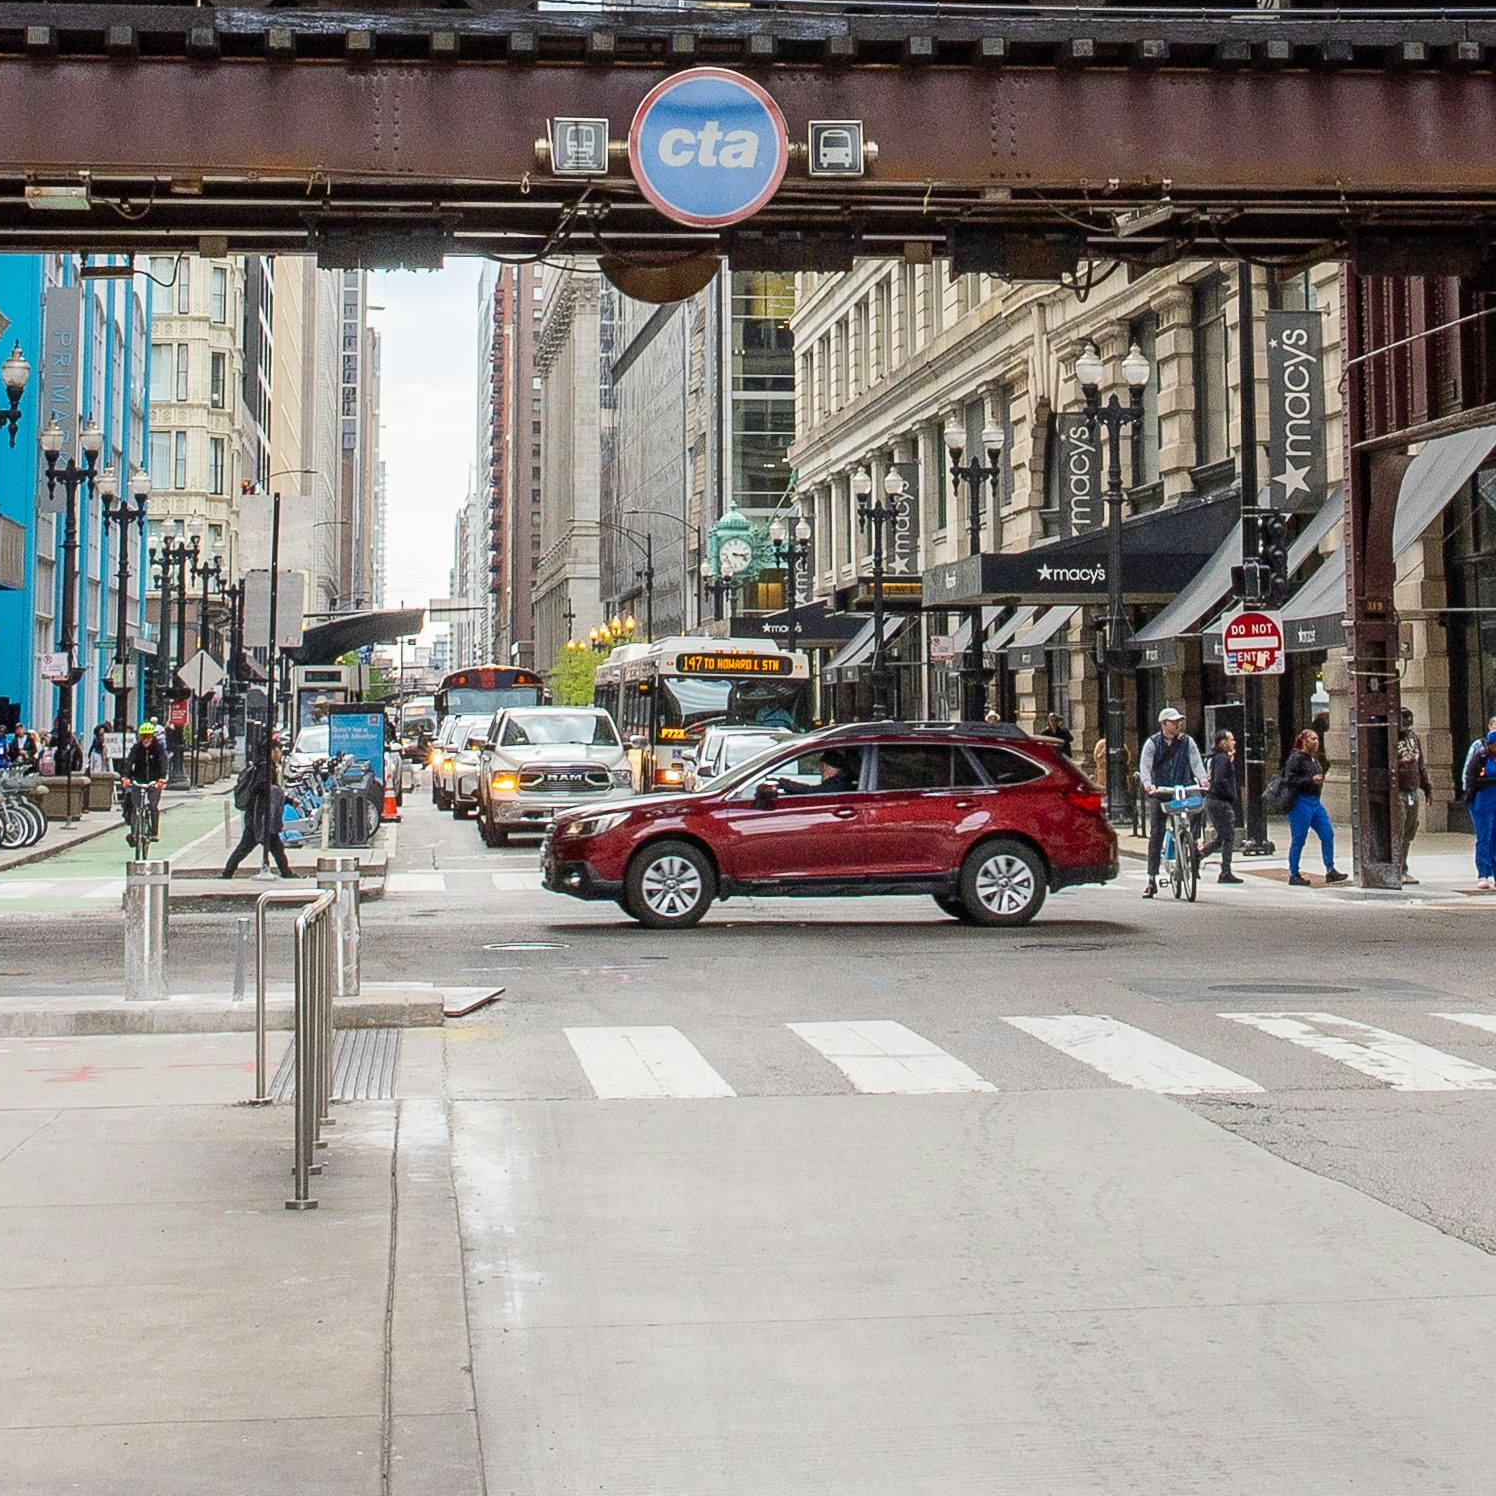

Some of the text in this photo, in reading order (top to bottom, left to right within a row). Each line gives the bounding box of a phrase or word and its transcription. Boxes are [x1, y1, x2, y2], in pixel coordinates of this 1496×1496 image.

[658, 120, 759, 169] cta
[1231, 623, 1273, 636] DO NOT
[683, 655, 702, 671] 147
[704, 658, 715, 670] TO
[717, 658, 752, 671] HOWARD
[762, 659, 780, 672] STN
[547, 773, 582, 782] RAM
